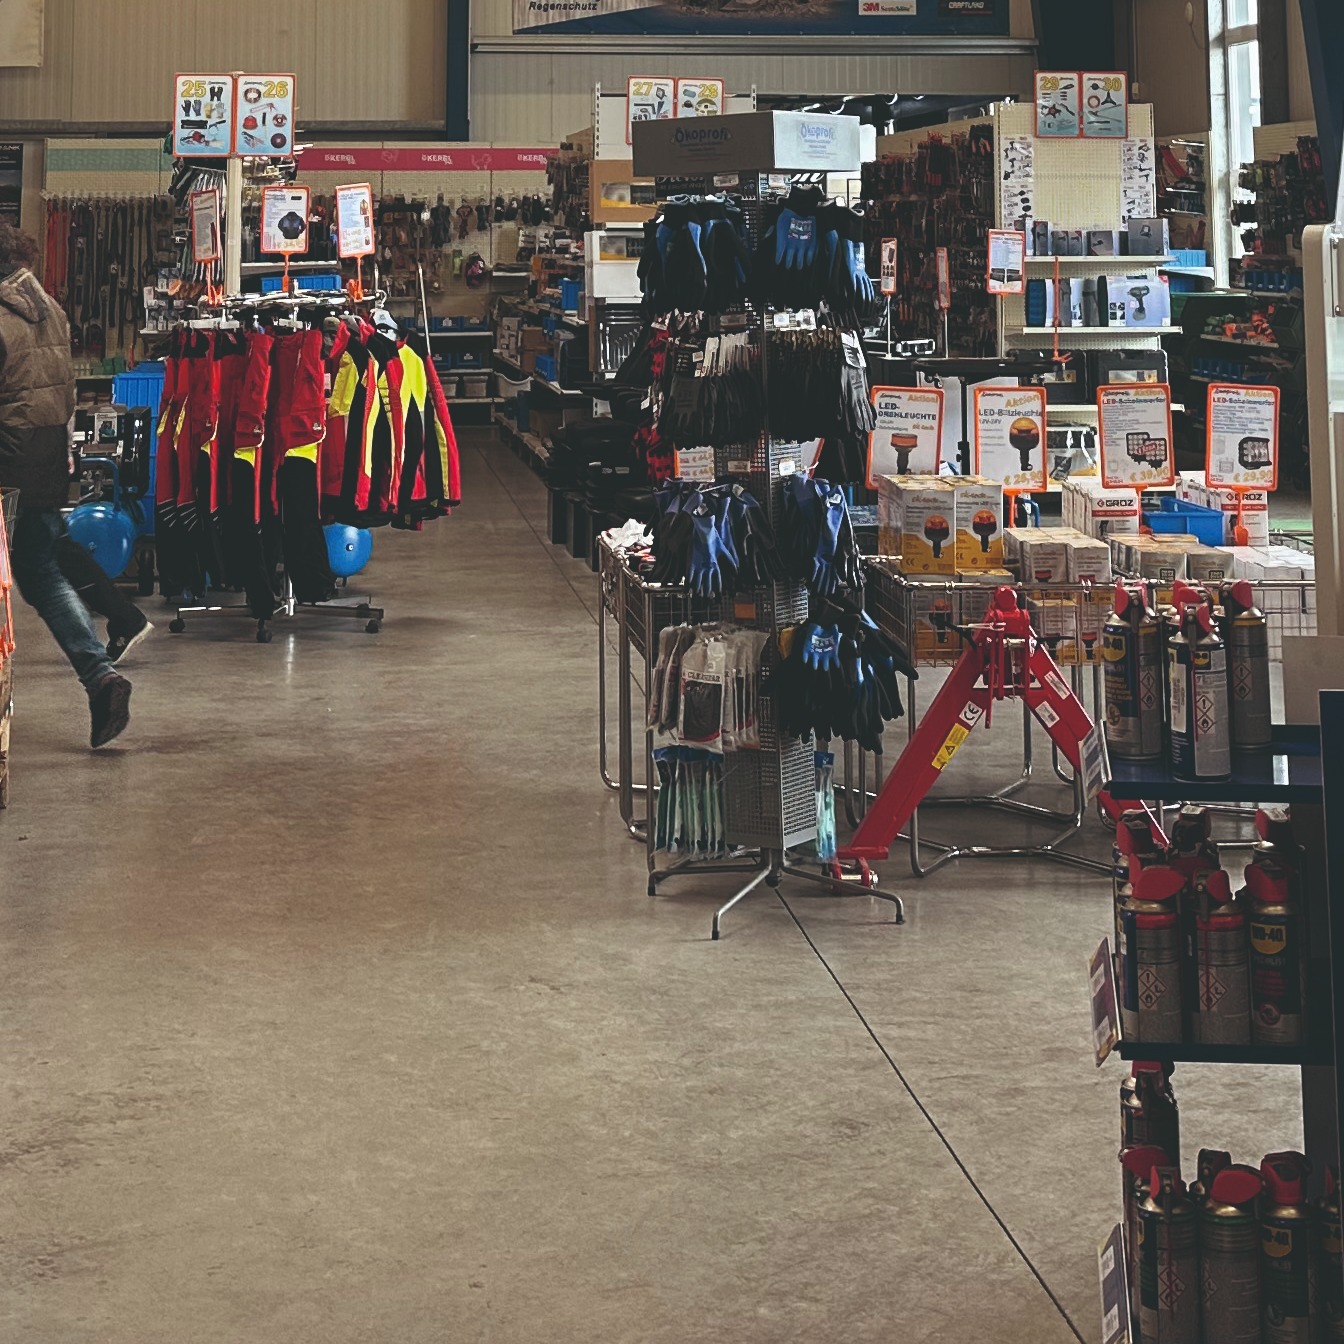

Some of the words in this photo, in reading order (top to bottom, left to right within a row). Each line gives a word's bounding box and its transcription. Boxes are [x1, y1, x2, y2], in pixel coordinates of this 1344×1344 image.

[529, 1, 597, 12] Regenschutz
[863, 2, 879, 12] 3M
[181, 80, 206, 98] 25
[263, 80, 288, 98] 26
[632, 82, 652, 96] 27
[1103, 76, 1122, 92] 30
[698, 83, 718, 98] 28
[674, 126, 729, 143] Ökoprofi
[800, 123, 834, 140] Ökoprofi
[878, 402, 900, 410] LED-
[1102, 397, 1165, 405] LED-Scheinwerfer
[1212, 397, 1275, 405] LED-Scheinwerfer
[878, 410, 937, 421] DREHLEUCHTE
[1105, 499, 1134, 507] GROZ
